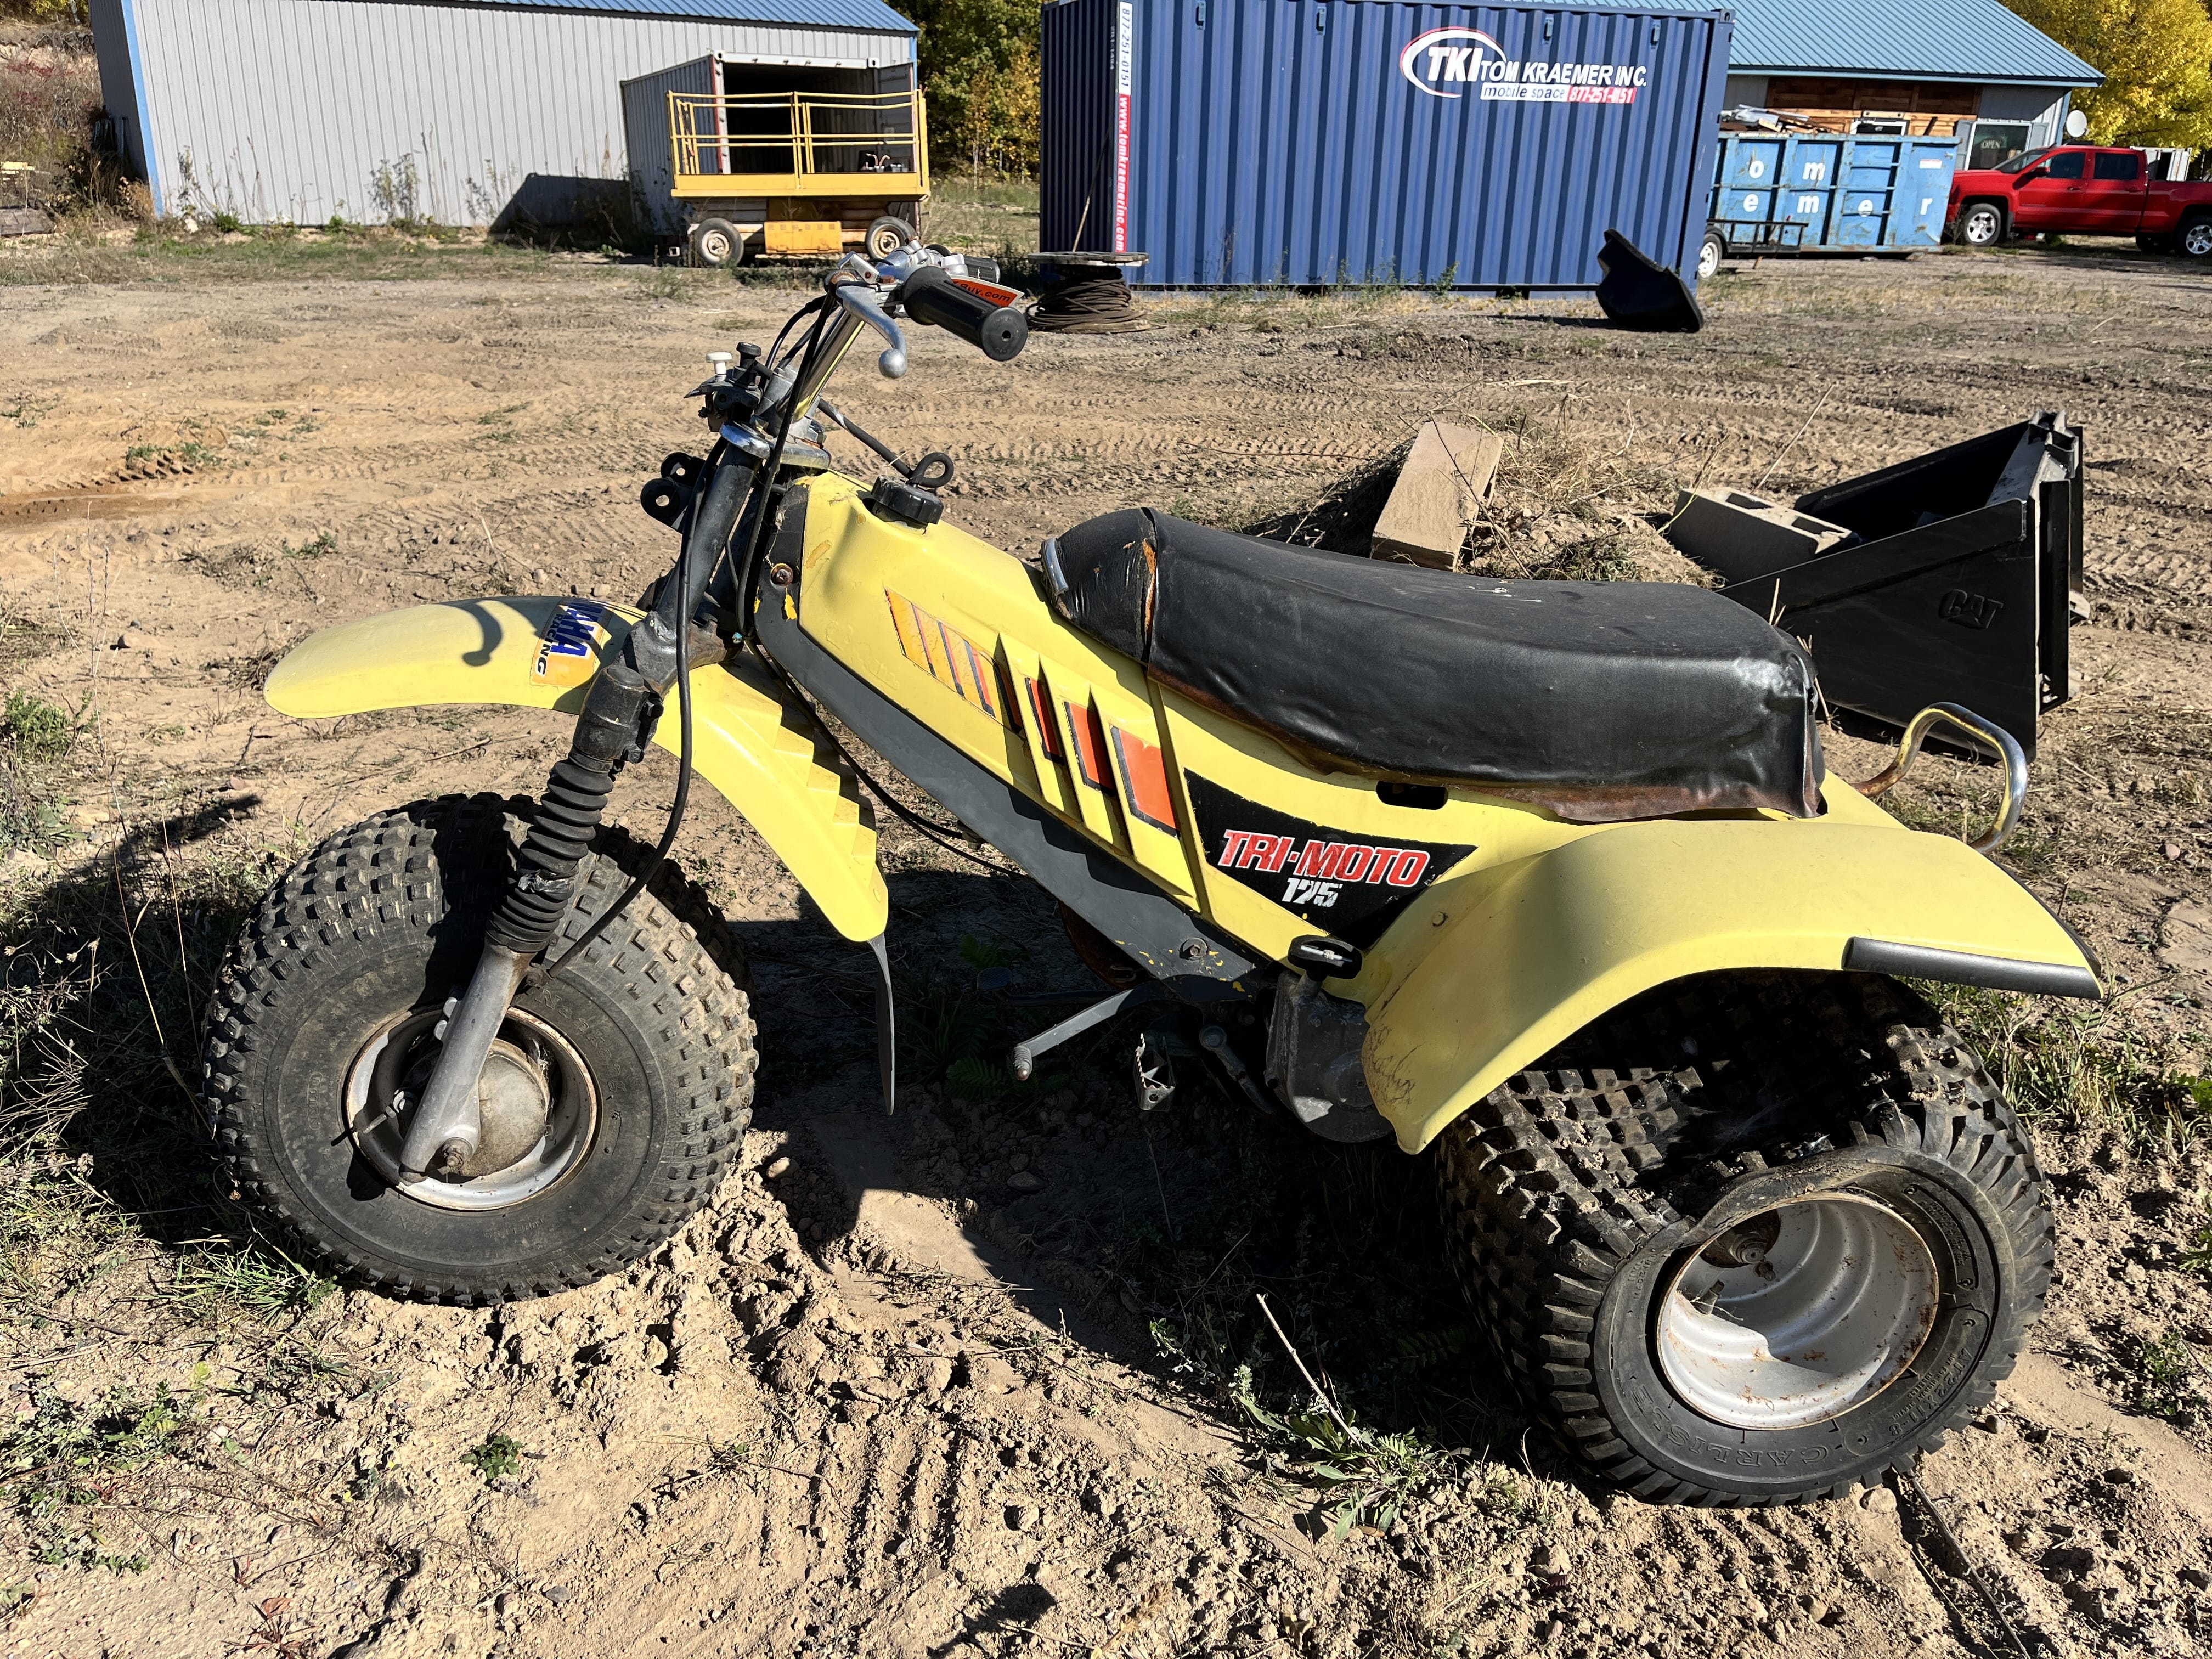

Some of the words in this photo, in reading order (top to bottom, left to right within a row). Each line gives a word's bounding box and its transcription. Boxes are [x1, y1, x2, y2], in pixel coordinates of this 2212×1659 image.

[1121, 8, 1130, 87] 877-251-0151
[1427, 46, 1483, 82] TKI
[1481, 60, 1520, 82] TOM
[1521, 61, 1614, 86] KRAEMER
[1615, 65, 1647, 87] INC.
[1483, 84, 1527, 98] mobile
[1531, 88, 1565, 100] space
[1982, 140, 2001, 149] OPEN
[1115, 97, 1129, 251] www.tomkraemerinc.com
[1938, 588, 2004, 629] CAT
[537, 614, 563, 675] RACING
[1217, 829, 1431, 887] TRI-MOTO
[1632, 1384, 1829, 1468] CARLISLE
